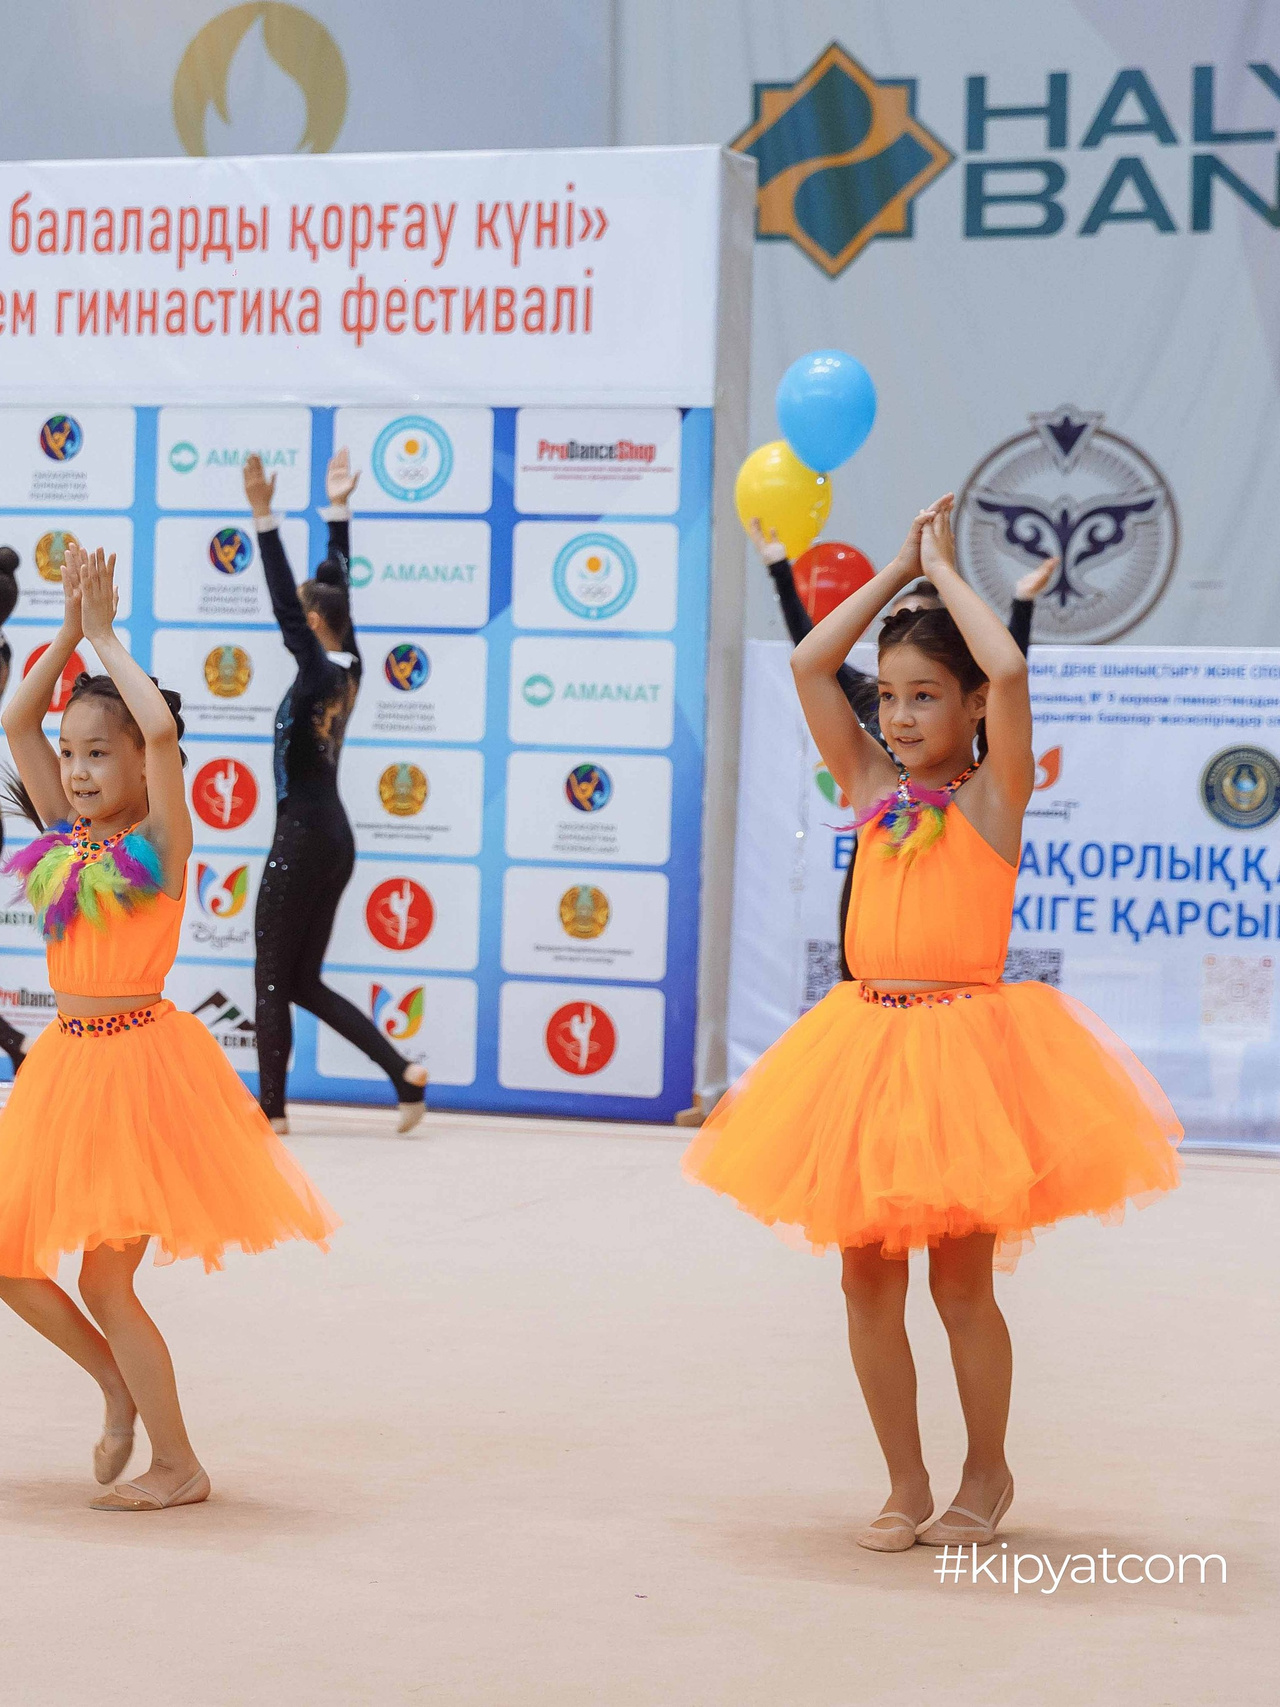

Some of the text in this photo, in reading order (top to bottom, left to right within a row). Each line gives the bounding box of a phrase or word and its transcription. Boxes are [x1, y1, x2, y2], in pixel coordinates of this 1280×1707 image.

[962, 154, 1280, 240] BAN
[8, 191, 271, 271] балаларды
[288, 200, 458, 270] қорғау
[474, 181, 610, 268] күні»
[53, 286, 323, 336] гимнастика
[340, 268, 595, 347] фестивалі
[380, 564, 477, 583] AMANAT
[562, 683, 661, 703] AMANAT
[1019, 841, 1280, 891] АҚОРЛЫҚҚ
[1112, 898, 1280, 942] ҚАРСЫ
